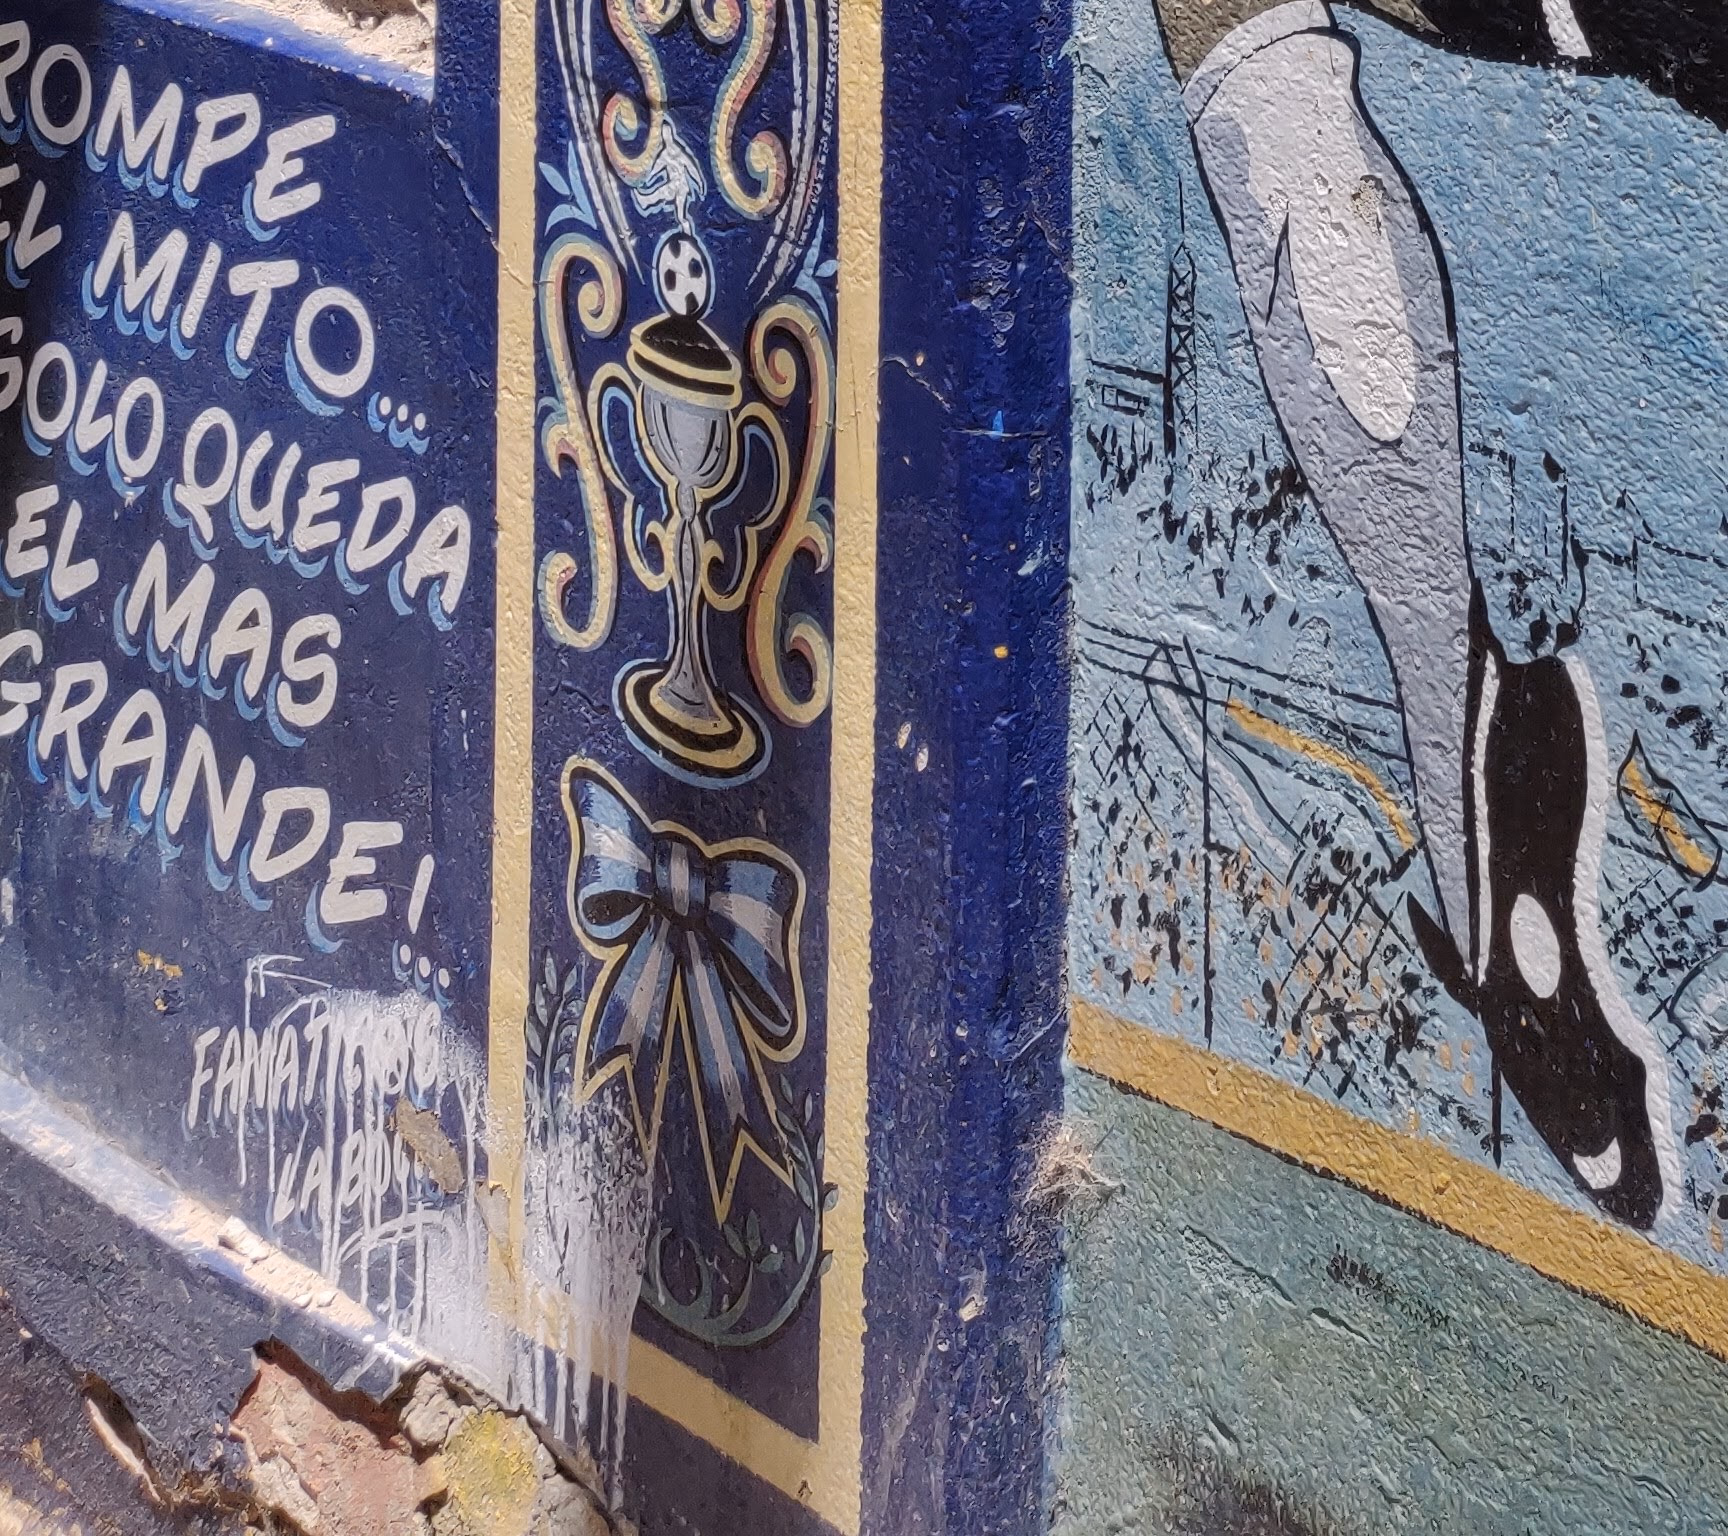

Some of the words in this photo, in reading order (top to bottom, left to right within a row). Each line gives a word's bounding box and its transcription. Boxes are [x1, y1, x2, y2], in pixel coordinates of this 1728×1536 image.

[4, 484, 99, 602] EL
[125, 540, 342, 728] MAS
[173, 406, 472, 615] QUEDA
